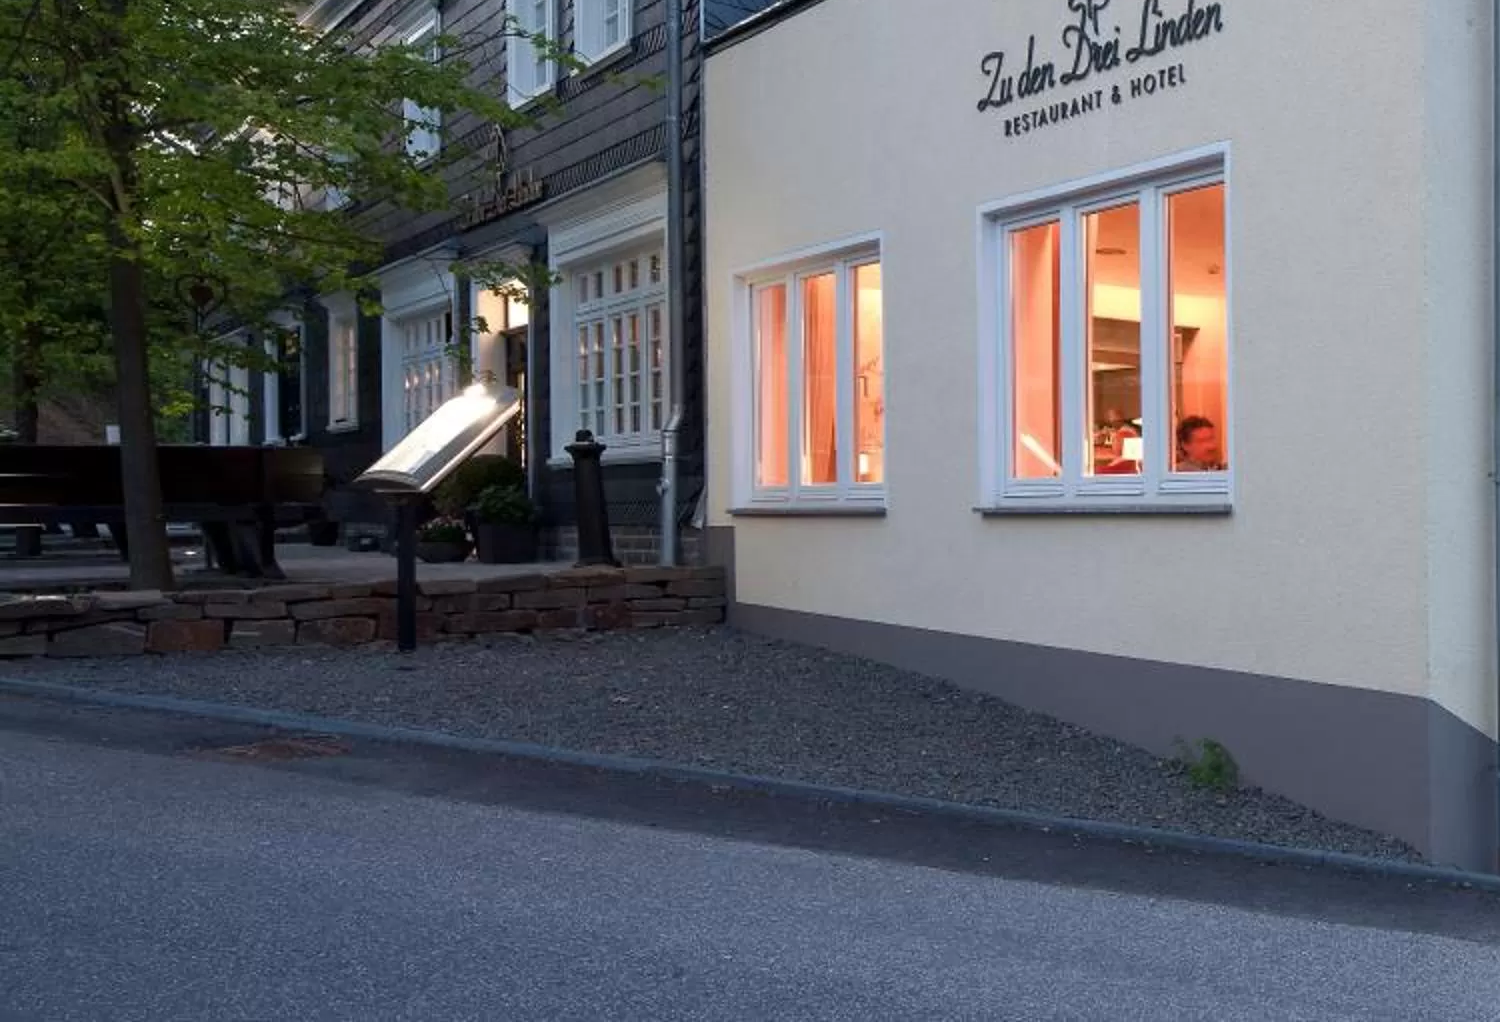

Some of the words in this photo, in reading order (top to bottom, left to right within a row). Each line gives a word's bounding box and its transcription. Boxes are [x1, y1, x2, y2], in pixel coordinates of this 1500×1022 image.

[977, 51, 1013, 112] Zu
[1017, 34, 1055, 99] den
[1060, 24, 1121, 85] Drei
[1004, 89, 1103, 137] RESTAURANT
[1111, 85, 1122, 104] &
[1130, 63, 1187, 98] HOTEL
